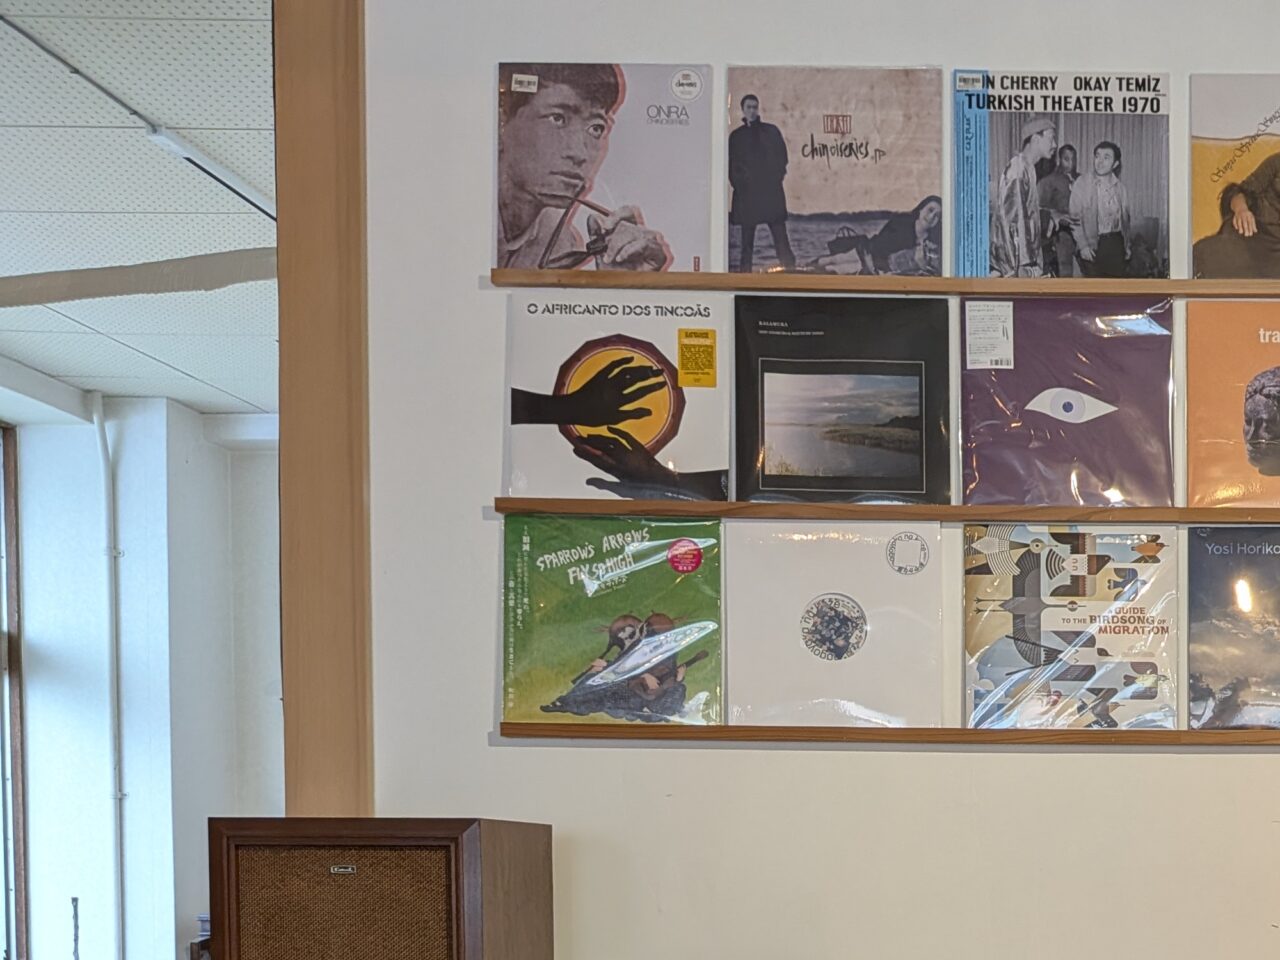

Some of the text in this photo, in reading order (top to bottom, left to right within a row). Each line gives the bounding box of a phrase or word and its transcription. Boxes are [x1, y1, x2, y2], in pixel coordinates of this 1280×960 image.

[1000, 75, 1058, 91] CHERRY
[1073, 76, 1111, 92] OKAY
[965, 93, 1161, 114] TURKISH THEATER 1970
[646, 104, 689, 119] ONRA
[527, 303, 711, 318] O AFRICANTO DOS TINCOÃS
[602, 528, 650, 553] ARROWS
[1205, 542, 1234, 555] Yosi
[567, 563, 590, 585] FLY
[605, 551, 635, 573] HIGH
[1114, 607, 1146, 615] GUIDE
[1089, 614, 1155, 625] BIRDSONG
[1098, 625, 1169, 635] MIGRATION
